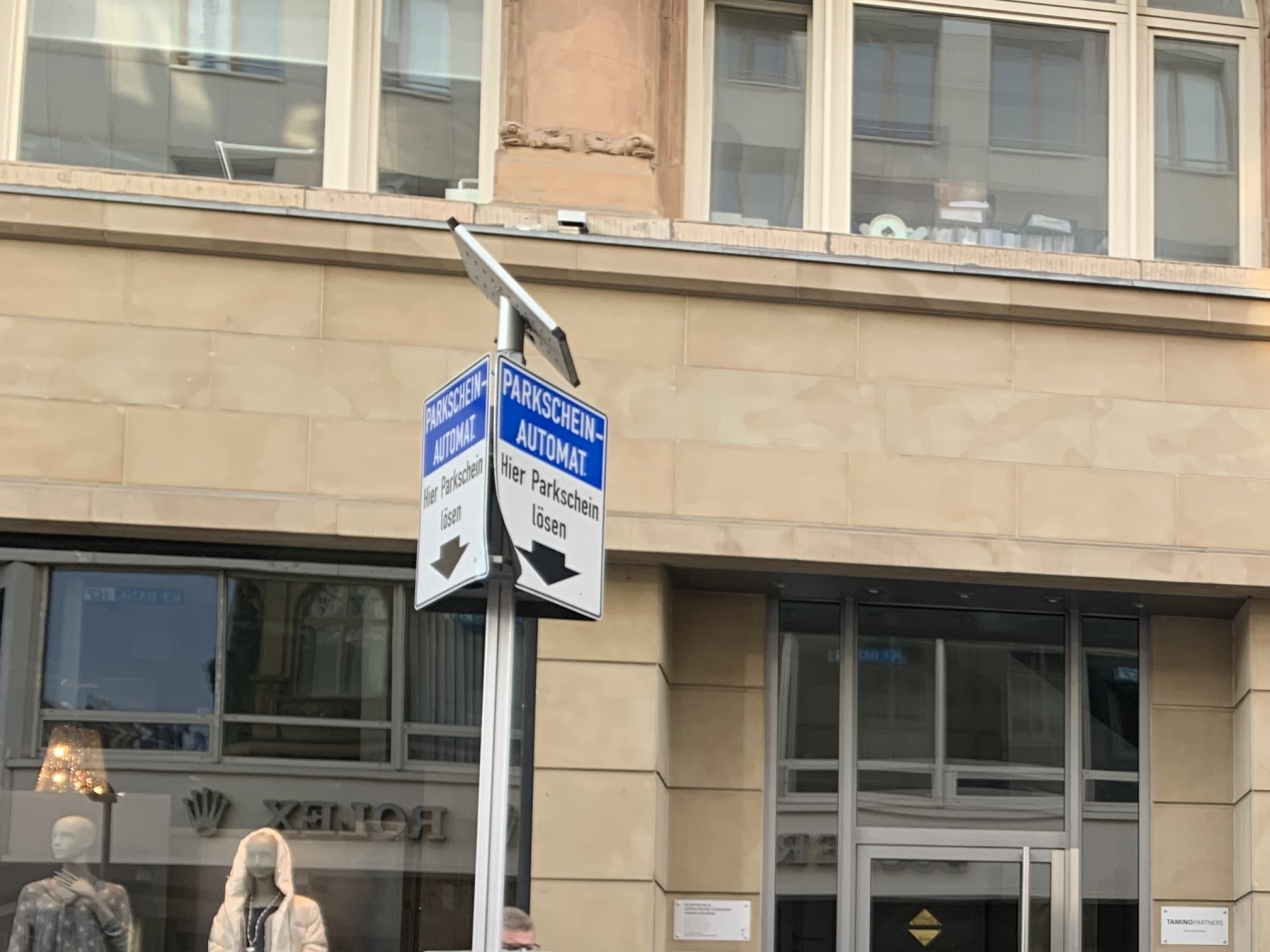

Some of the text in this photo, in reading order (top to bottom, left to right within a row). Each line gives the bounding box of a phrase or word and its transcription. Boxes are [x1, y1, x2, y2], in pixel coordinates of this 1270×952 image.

[425, 370, 487, 434] PARKSCHEIN-
[502, 367, 604, 443] PARKSCHEIN-
[423, 454, 484, 510] Hier Parkschein
[500, 452, 599, 522] Hier Parkschein
[440, 504, 462, 532] lösen
[532, 503, 567, 540] lösen
